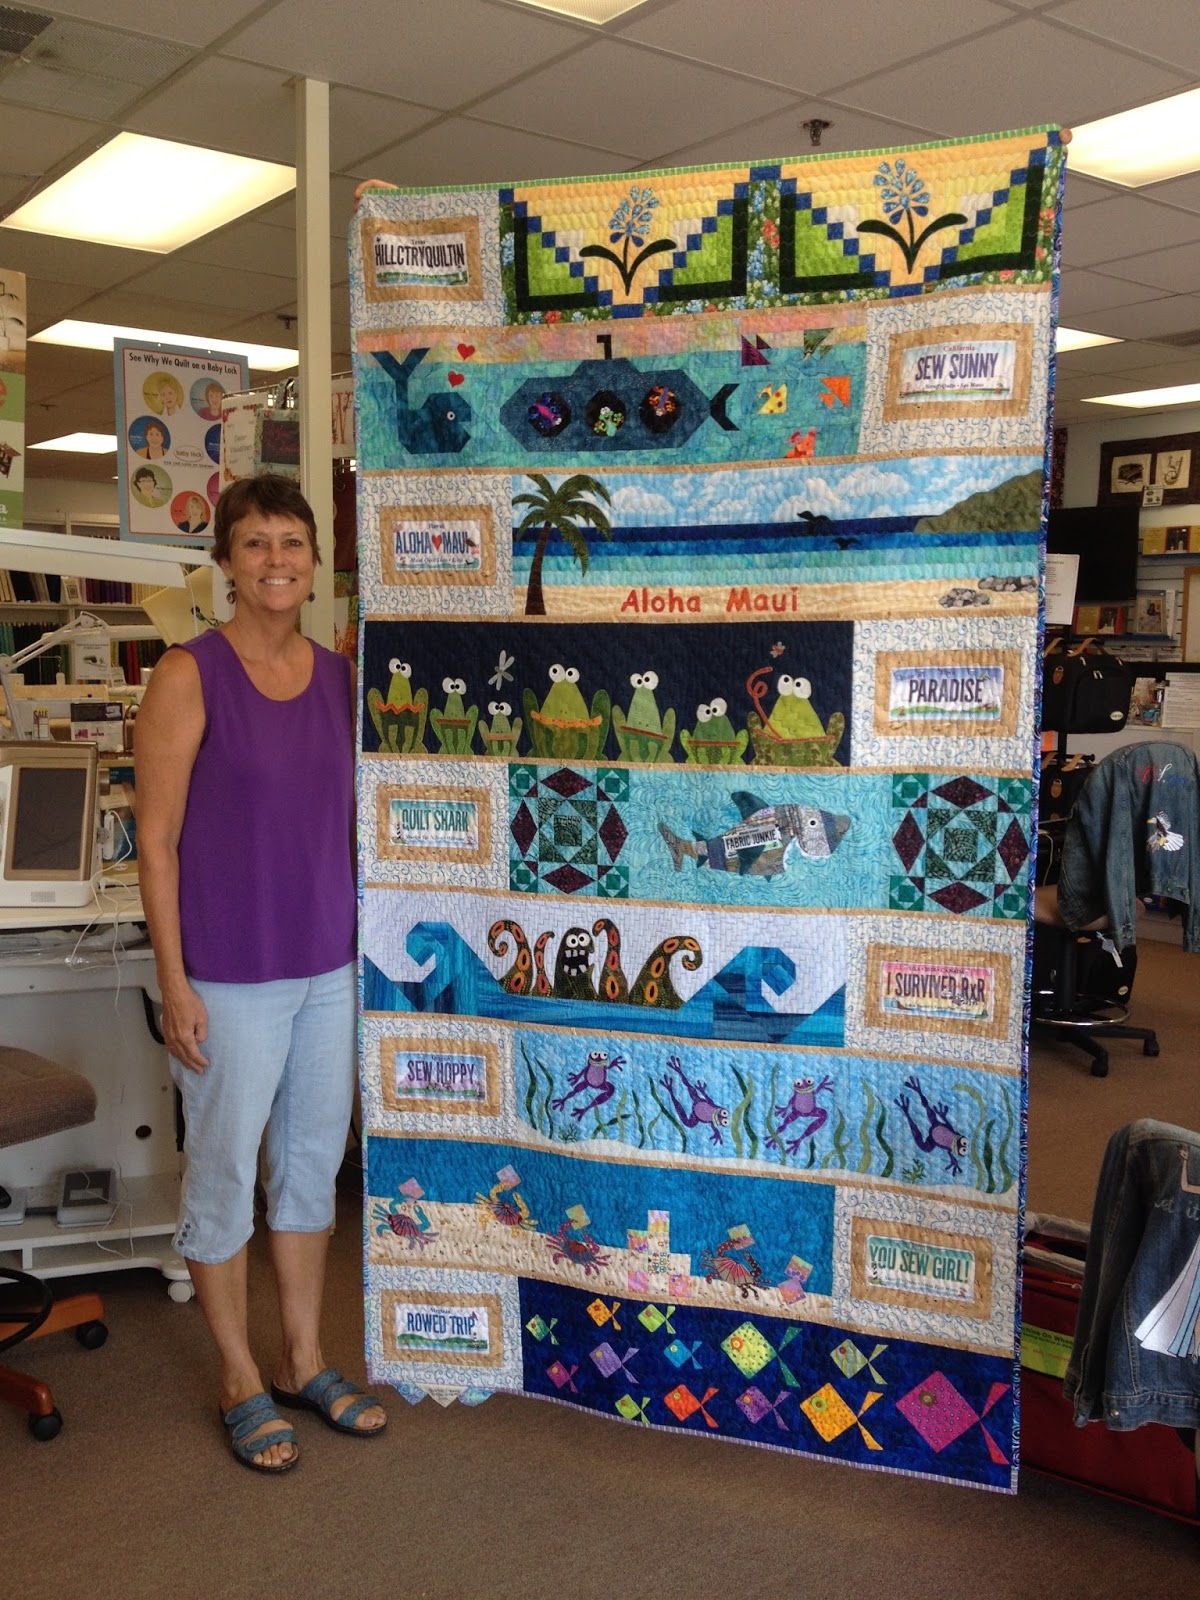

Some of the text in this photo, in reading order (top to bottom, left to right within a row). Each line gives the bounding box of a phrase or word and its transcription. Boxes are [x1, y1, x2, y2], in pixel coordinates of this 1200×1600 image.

[374, 243, 465, 268] HILLCTRYQUILTIN
[129, 352, 142, 362] See
[143, 354, 159, 366] Why
[161, 356, 173, 366] We
[174, 358, 190, 368] Quilt
[207, 363, 223, 374] Baby
[224, 365, 238, 375] Lock
[915, 352, 999, 381] SEW SUNNY
[395, 531, 469, 554] ALOHA MAUI
[620, 586, 799, 613] Aloha Maui
[909, 678, 984, 703] PARADISE
[33, 710, 48, 719] SALE
[402, 808, 468, 832] QUILT SHARK
[725, 829, 776, 850] FABRIC JUNKIE
[886, 972, 985, 1002] I SURVIVED RxR
[407, 1060, 475, 1084] SEW HOPPY
[869, 1245, 897, 1270] YOU
[900, 1249, 929, 1276] SEW
[932, 1255, 970, 1283] GIRL!
[407, 1312, 476, 1336] ROWED TRIP
